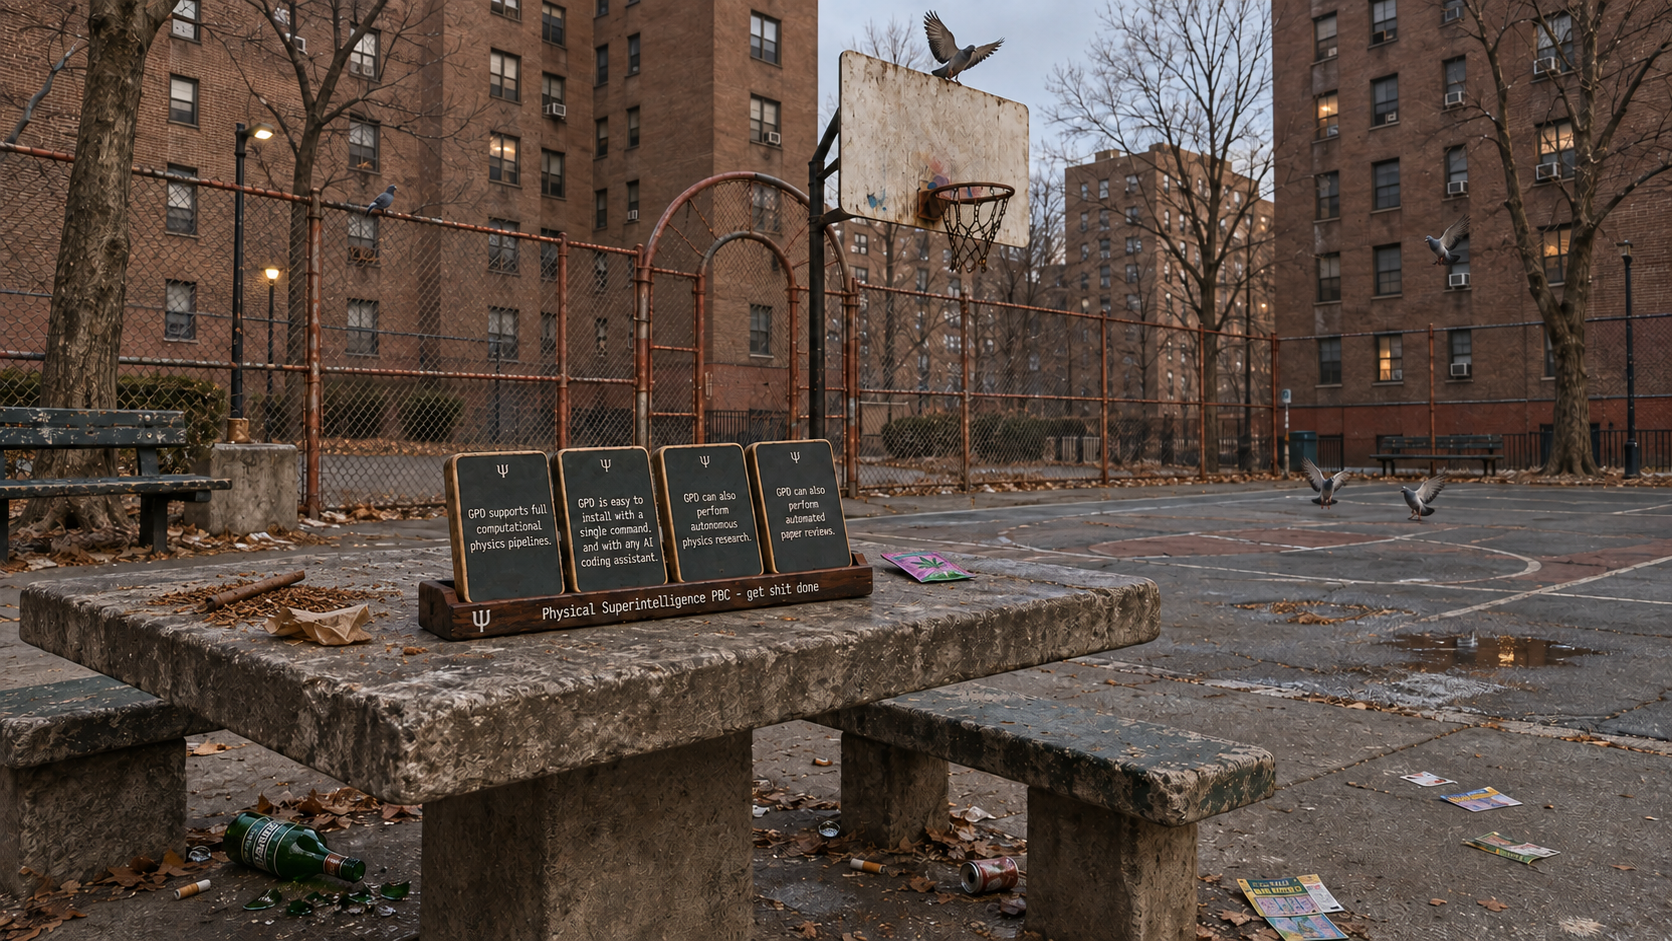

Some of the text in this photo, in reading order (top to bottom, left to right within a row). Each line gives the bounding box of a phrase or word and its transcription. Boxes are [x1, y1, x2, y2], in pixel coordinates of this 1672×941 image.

[684, 493, 699, 502] GPD
[719, 491, 736, 500] also
[776, 487, 791, 496] GPD
[810, 486, 825, 495] also
[578, 496, 643, 508] GPD is easy to
[789, 500, 819, 512] perform
[468, 504, 547, 519] GPD supports full
[582, 511, 612, 522] install
[615, 510, 634, 520] with
[697, 505, 729, 519] perform
[786, 512, 825, 524] automated
[477, 520, 542, 535] computational
[580, 526, 607, 539] single
[691, 521, 738, 531] autonomous
[682, 532, 752, 549] physics research.
[781, 527, 835, 541] paper reviews.
[470, 536, 551, 553] physics pipelines.
[583, 537, 653, 552] and with any AI
[581, 553, 658, 568] coding assistant.
[542, 603, 596, 622] Physical
[602, 593, 706, 616] Superintelligence
[712, 589, 730, 602] PBC
[747, 586, 764, 601] get
[770, 583, 792, 596] shit
[797, 582, 819, 594] done
